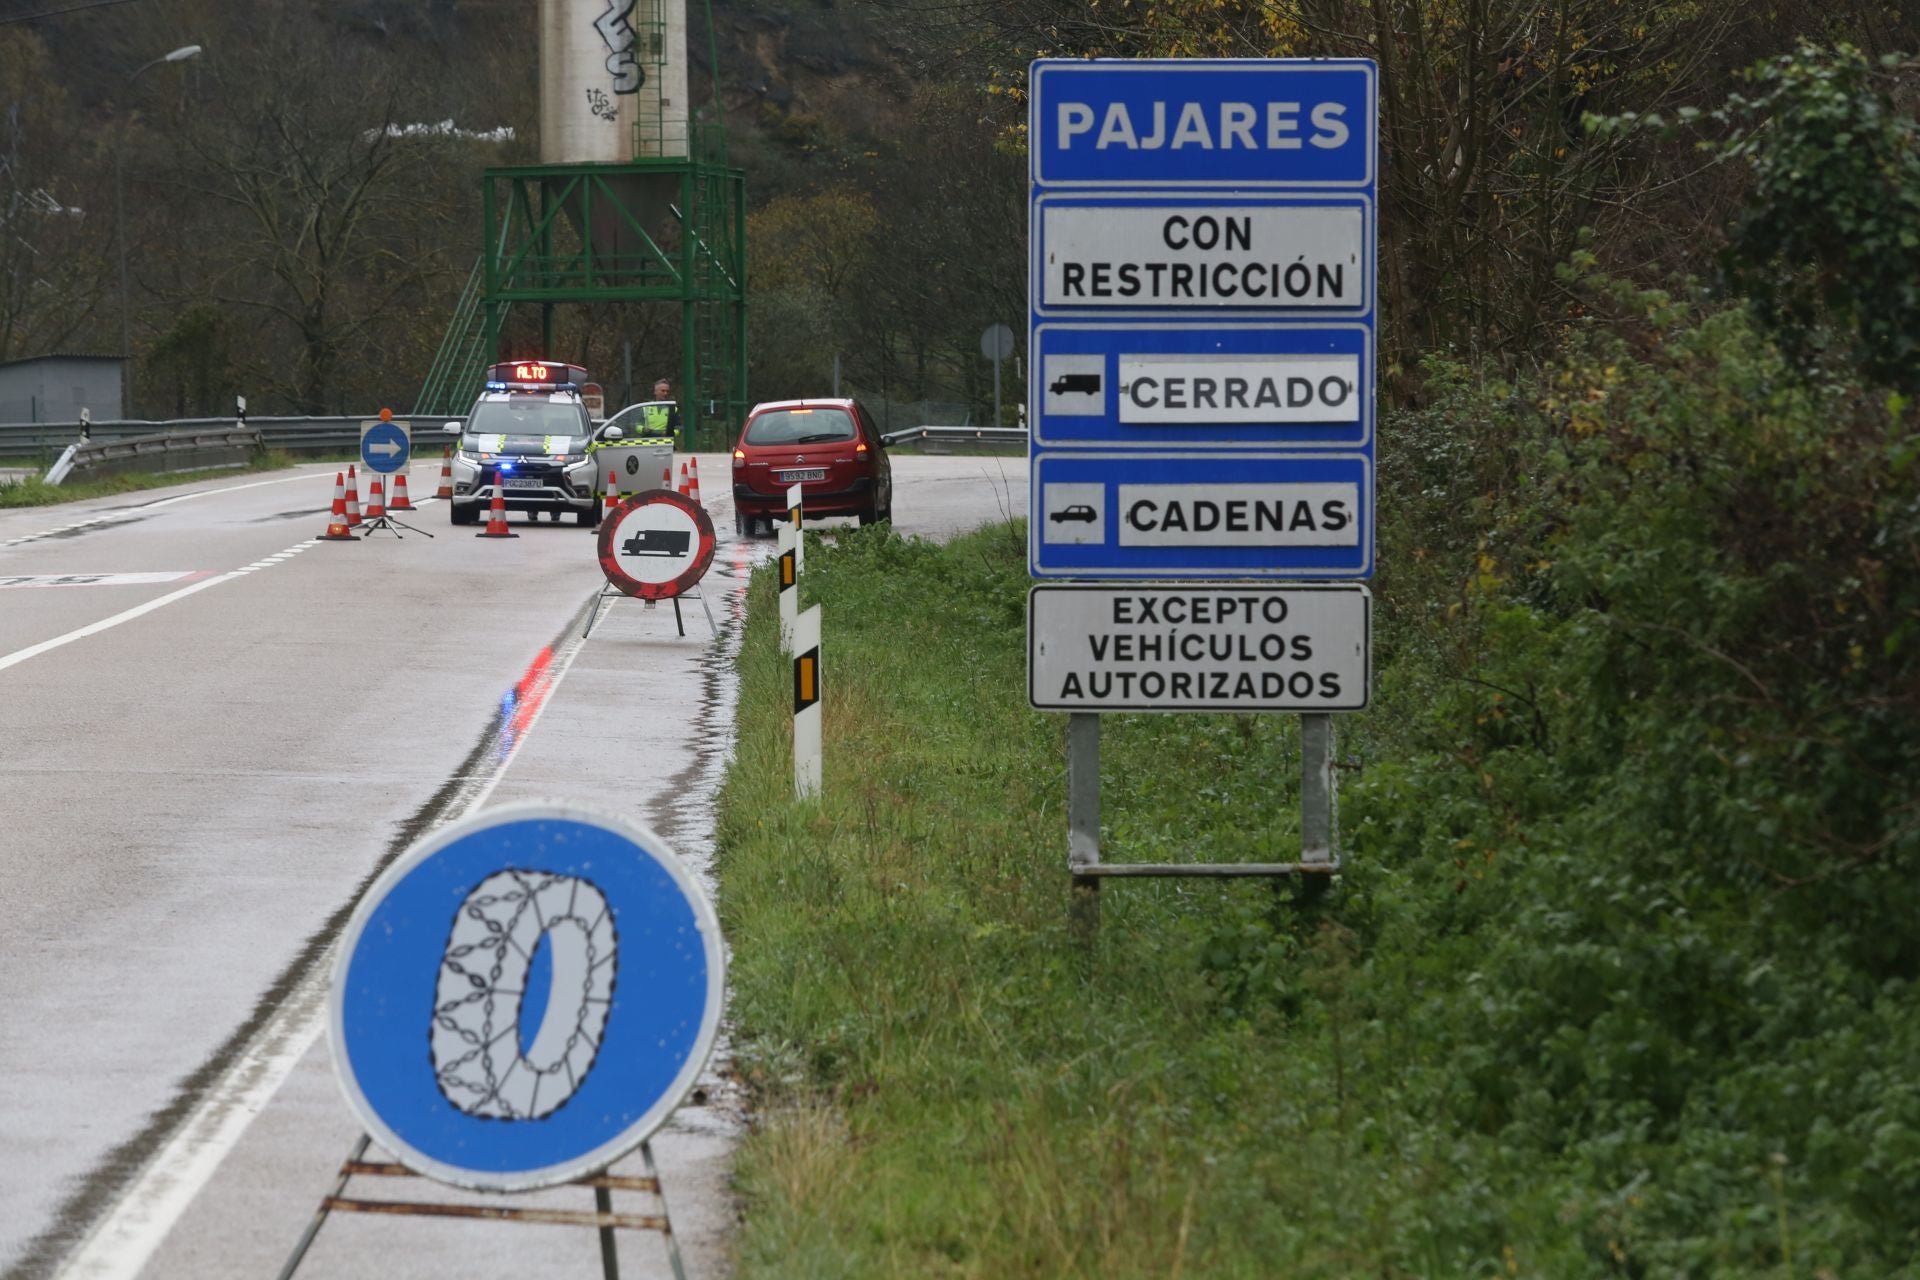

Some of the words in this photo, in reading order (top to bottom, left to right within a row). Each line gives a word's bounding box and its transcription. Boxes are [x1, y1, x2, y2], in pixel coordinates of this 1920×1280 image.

[1058, 102, 1348, 149] PAJARES
[1163, 215, 1251, 250] CON
[1063, 255, 1342, 298] RESTRICCIÓN
[516, 366, 547, 379] ALTO
[1131, 376, 1348, 408] CERRADO
[1130, 500, 1348, 532] CADENAS
[1114, 596, 1288, 624] EXCEPTO
[1089, 628, 1312, 661] VEHÍCULOS
[1060, 671, 1341, 699] AUTORIZADOS
